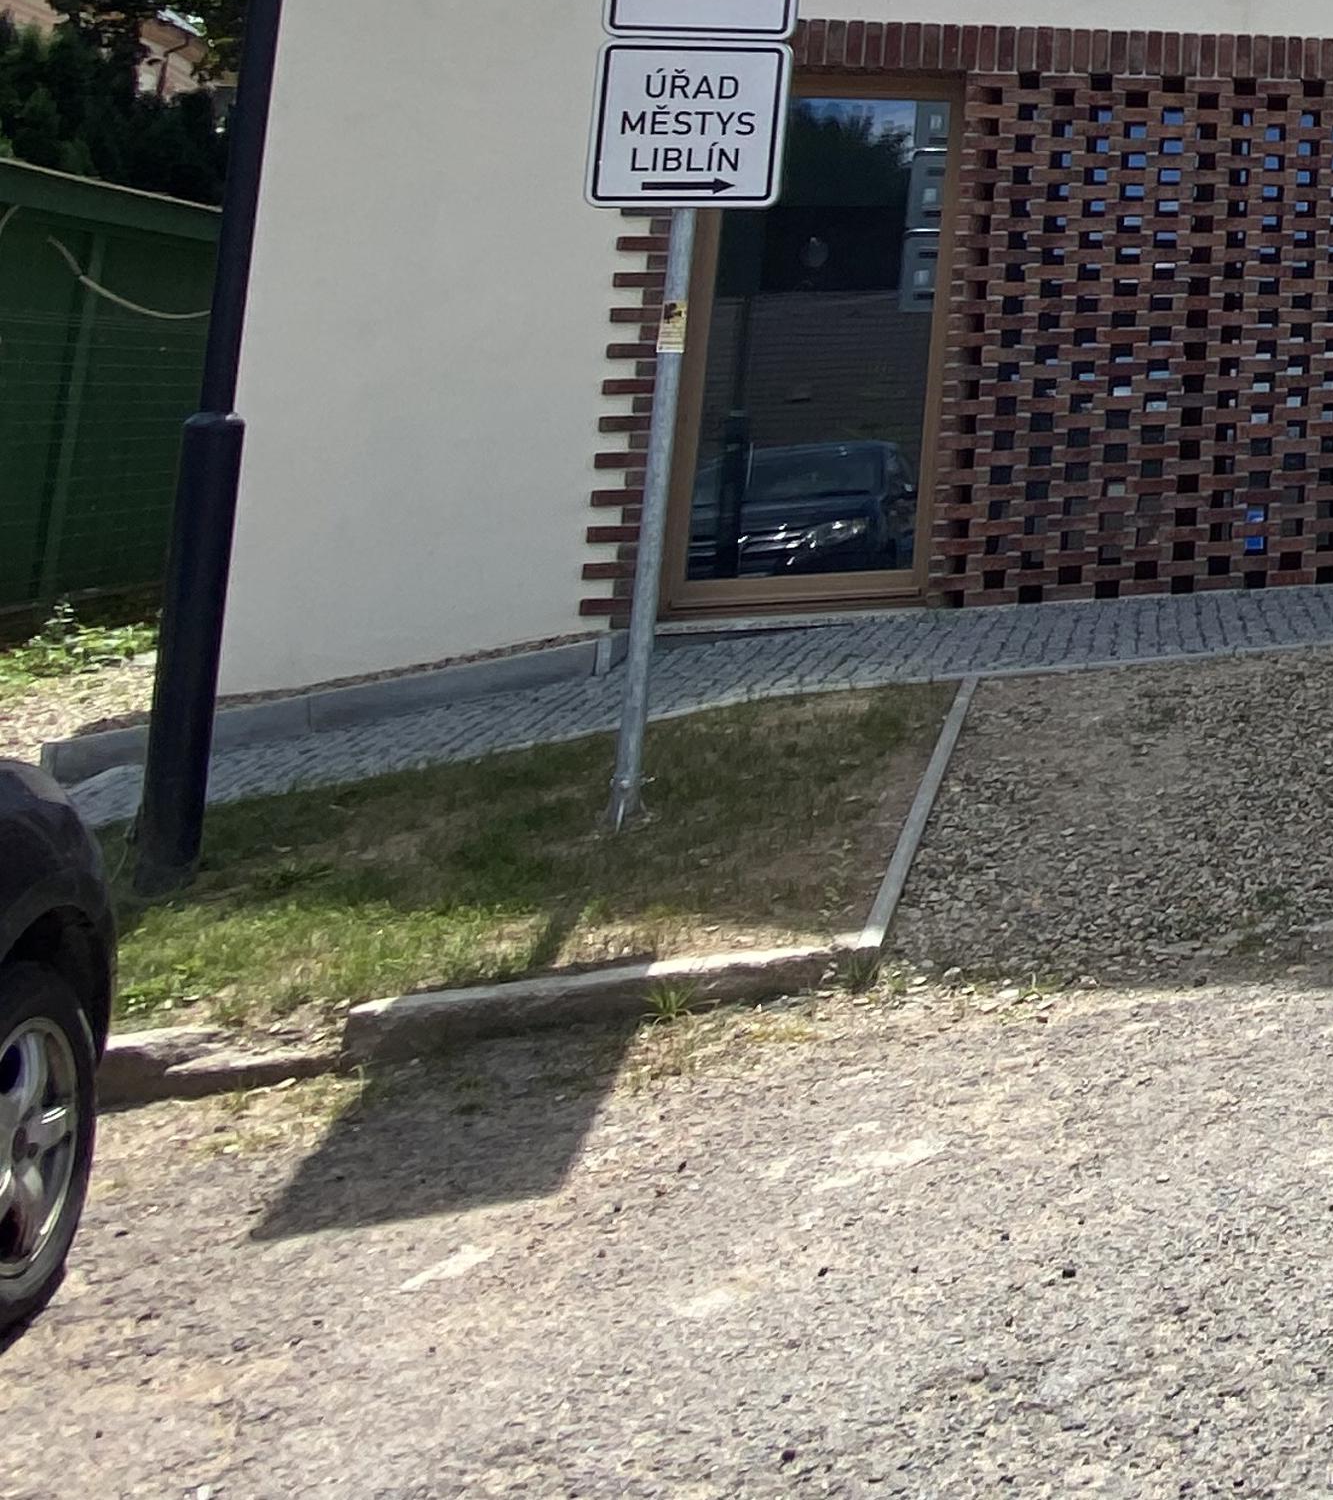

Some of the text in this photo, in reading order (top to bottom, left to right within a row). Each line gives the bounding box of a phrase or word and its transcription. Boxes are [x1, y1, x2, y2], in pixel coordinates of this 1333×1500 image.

[645, 68, 739, 99] ÚŘAD
[620, 105, 756, 136] MĚSTYS
[630, 142, 740, 172] LIBLÍN
